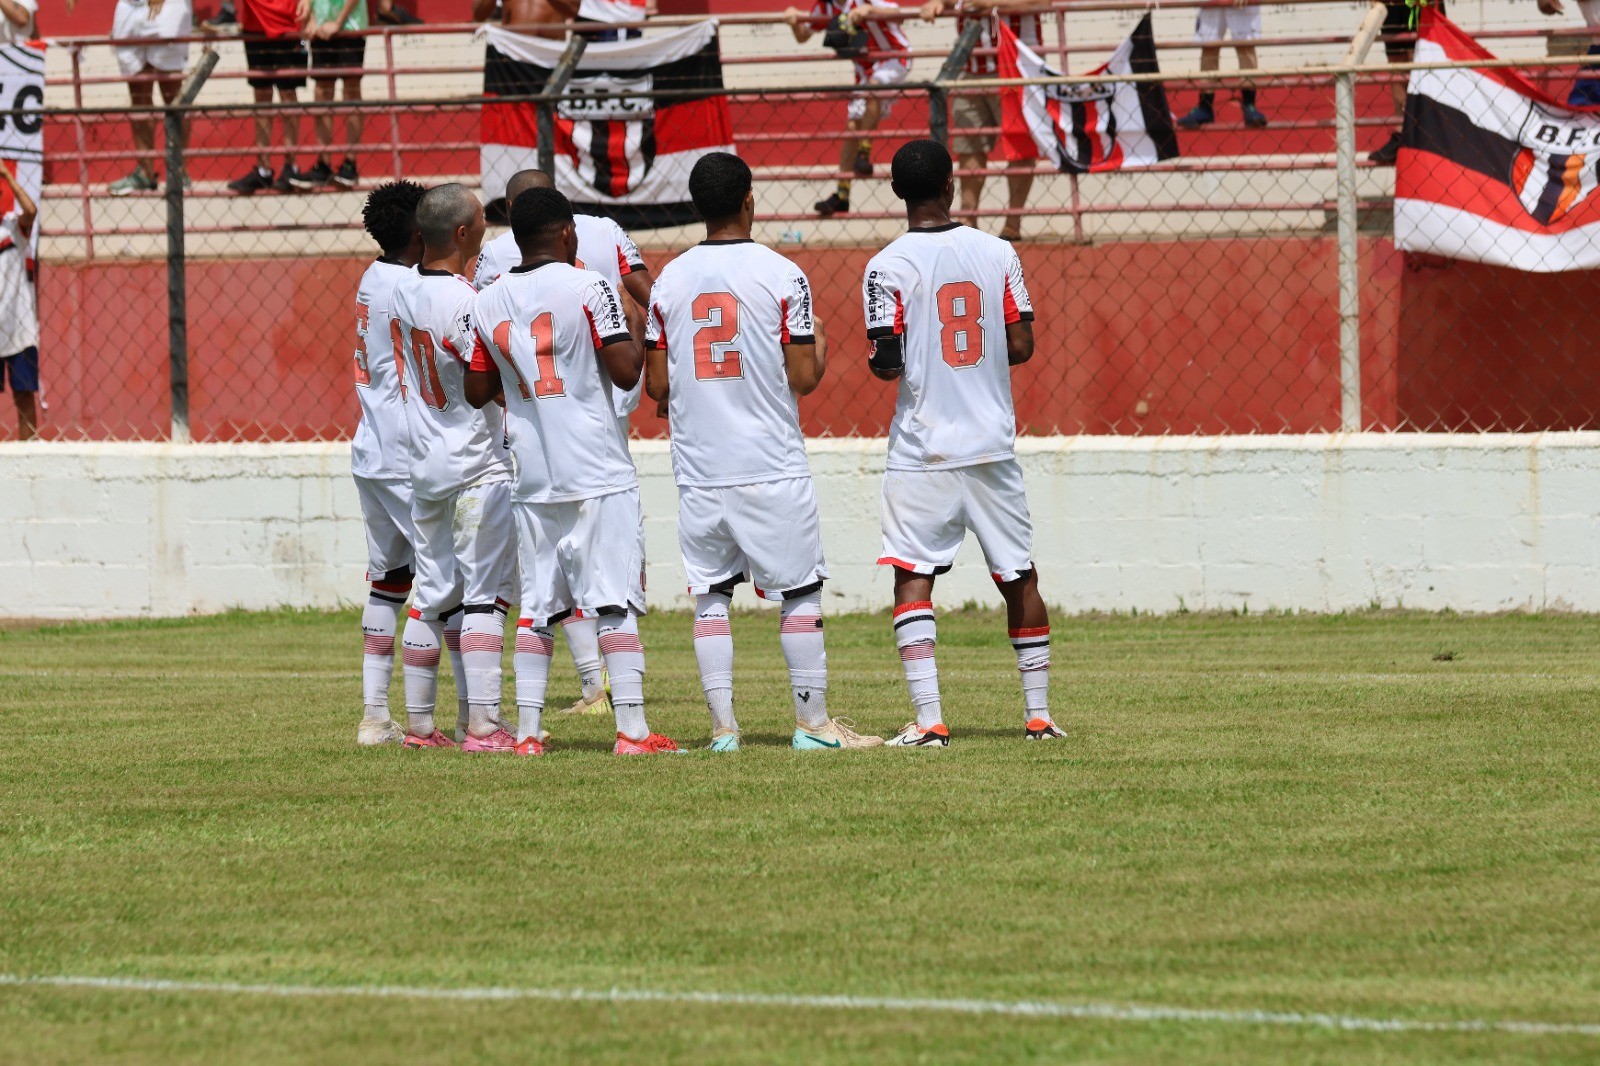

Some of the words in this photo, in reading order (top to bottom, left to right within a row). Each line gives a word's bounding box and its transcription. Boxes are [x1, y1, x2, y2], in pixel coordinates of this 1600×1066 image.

[598, 279, 621, 329] SERMED
[691, 291, 744, 382] 2
[867, 270, 878, 323] SERMED
[936, 280, 985, 370] 8
[492, 312, 566, 401] 11
